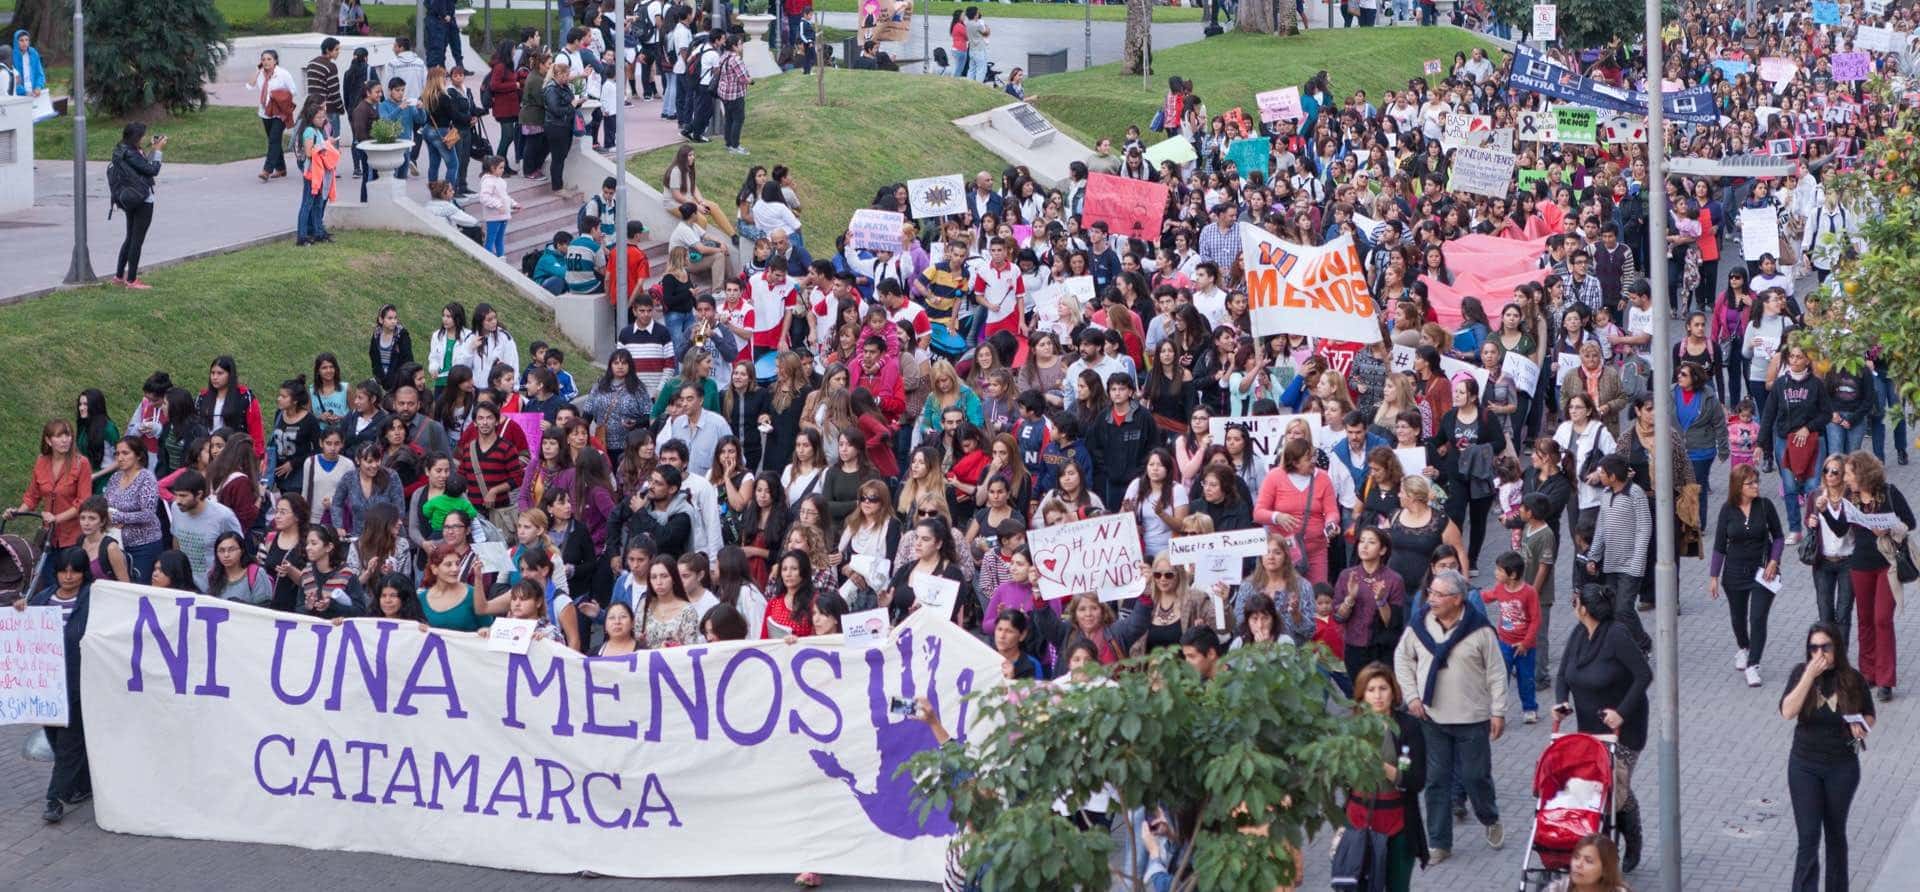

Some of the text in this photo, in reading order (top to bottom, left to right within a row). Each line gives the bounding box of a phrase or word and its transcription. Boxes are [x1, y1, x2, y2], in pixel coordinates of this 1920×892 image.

[1510, 73, 1555, 91] CONTRA
[1559, 118, 1589, 128] MENOS
[1572, 112, 1590, 120] UNA
[1258, 241, 1363, 287] NI UNA
[1247, 268, 1375, 318] MENOS
[1395, 353, 1409, 367] #
[1022, 425, 1033, 439] E
[1025, 450, 1038, 464] N
[1073, 522, 1121, 552] # NI
[1083, 546, 1130, 569] UNA
[1072, 560, 1141, 592] MENOS
[128, 597, 843, 746] NI UNA MENOS
[254, 734, 682, 829] CATAMARCA
